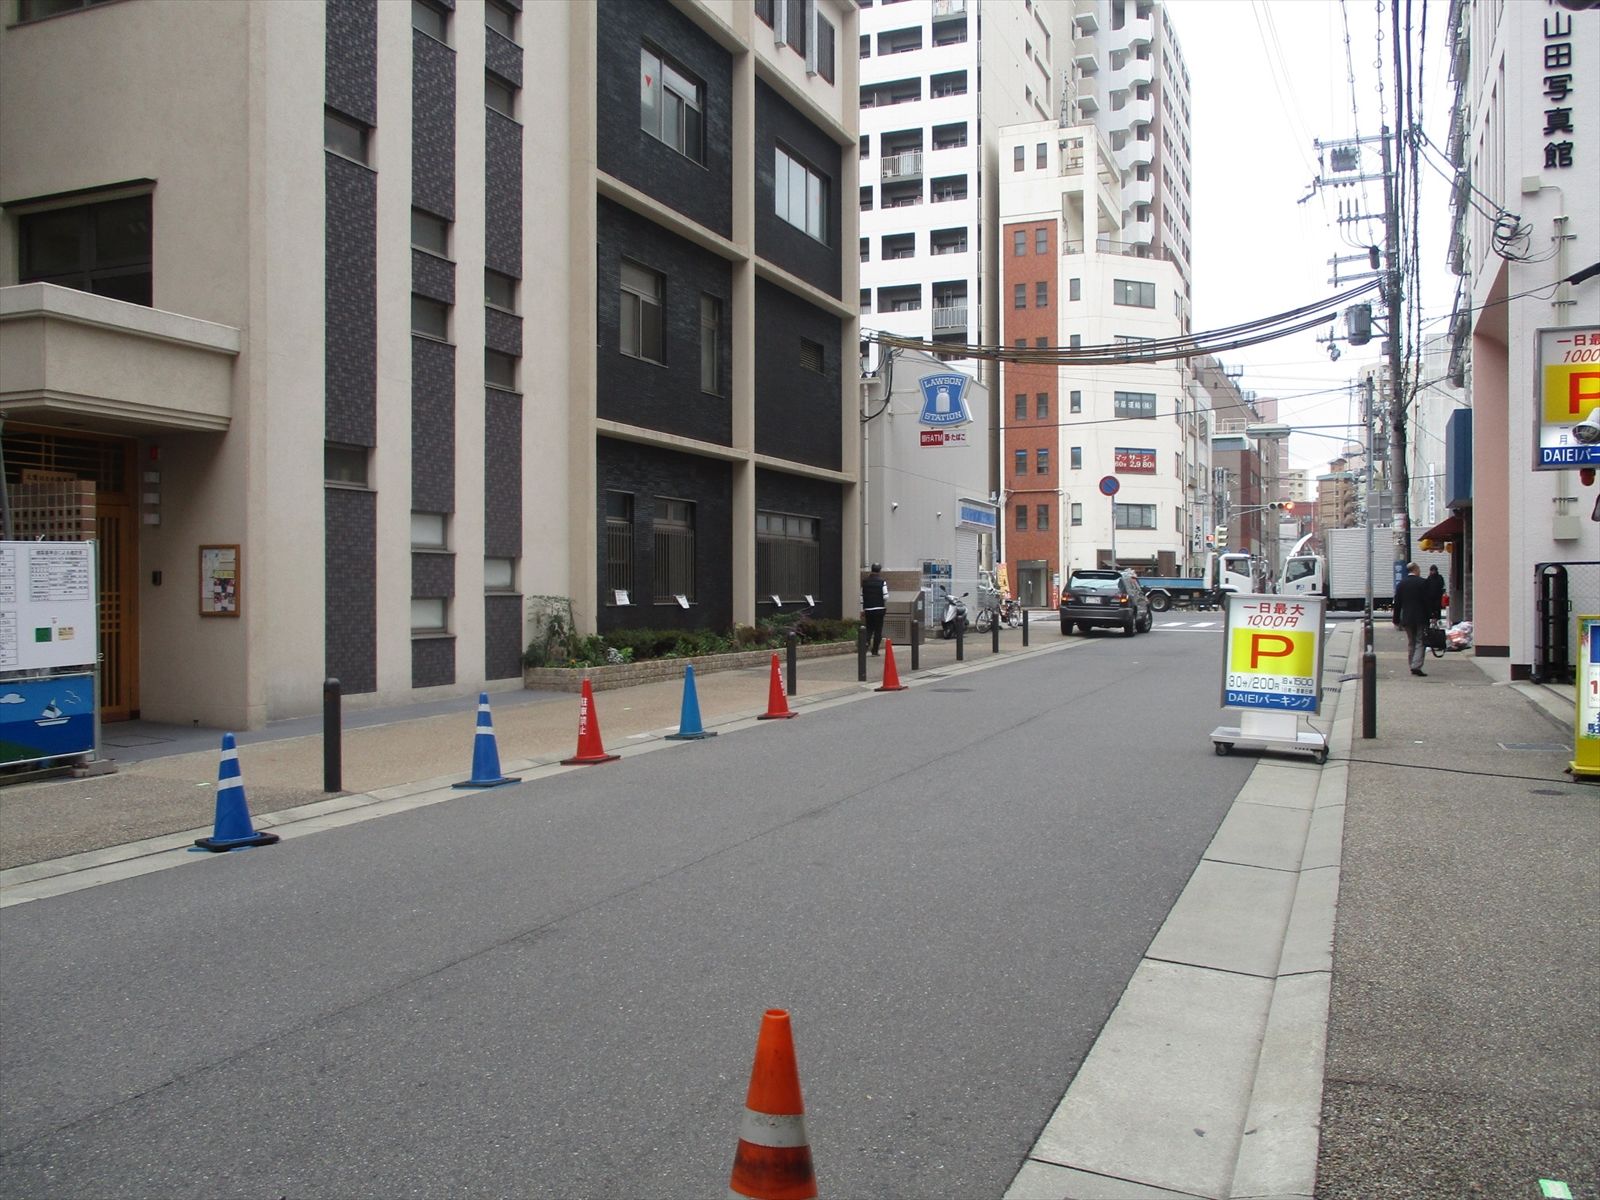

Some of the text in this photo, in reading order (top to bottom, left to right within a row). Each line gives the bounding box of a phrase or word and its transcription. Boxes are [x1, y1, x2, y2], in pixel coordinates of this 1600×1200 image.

[1543, 11, 1574, 169] 山田写真館
[924, 377, 963, 388] LAWSON
[1568, 371, 1600, 414] P
[924, 411, 963, 421] STATION
[1243, 602, 1305, 616] 一日最大
[1247, 615, 1299, 628] 1000円
[1250, 634, 1295, 669] P
[1228, 692, 1312, 708] DAIEIパーキング
